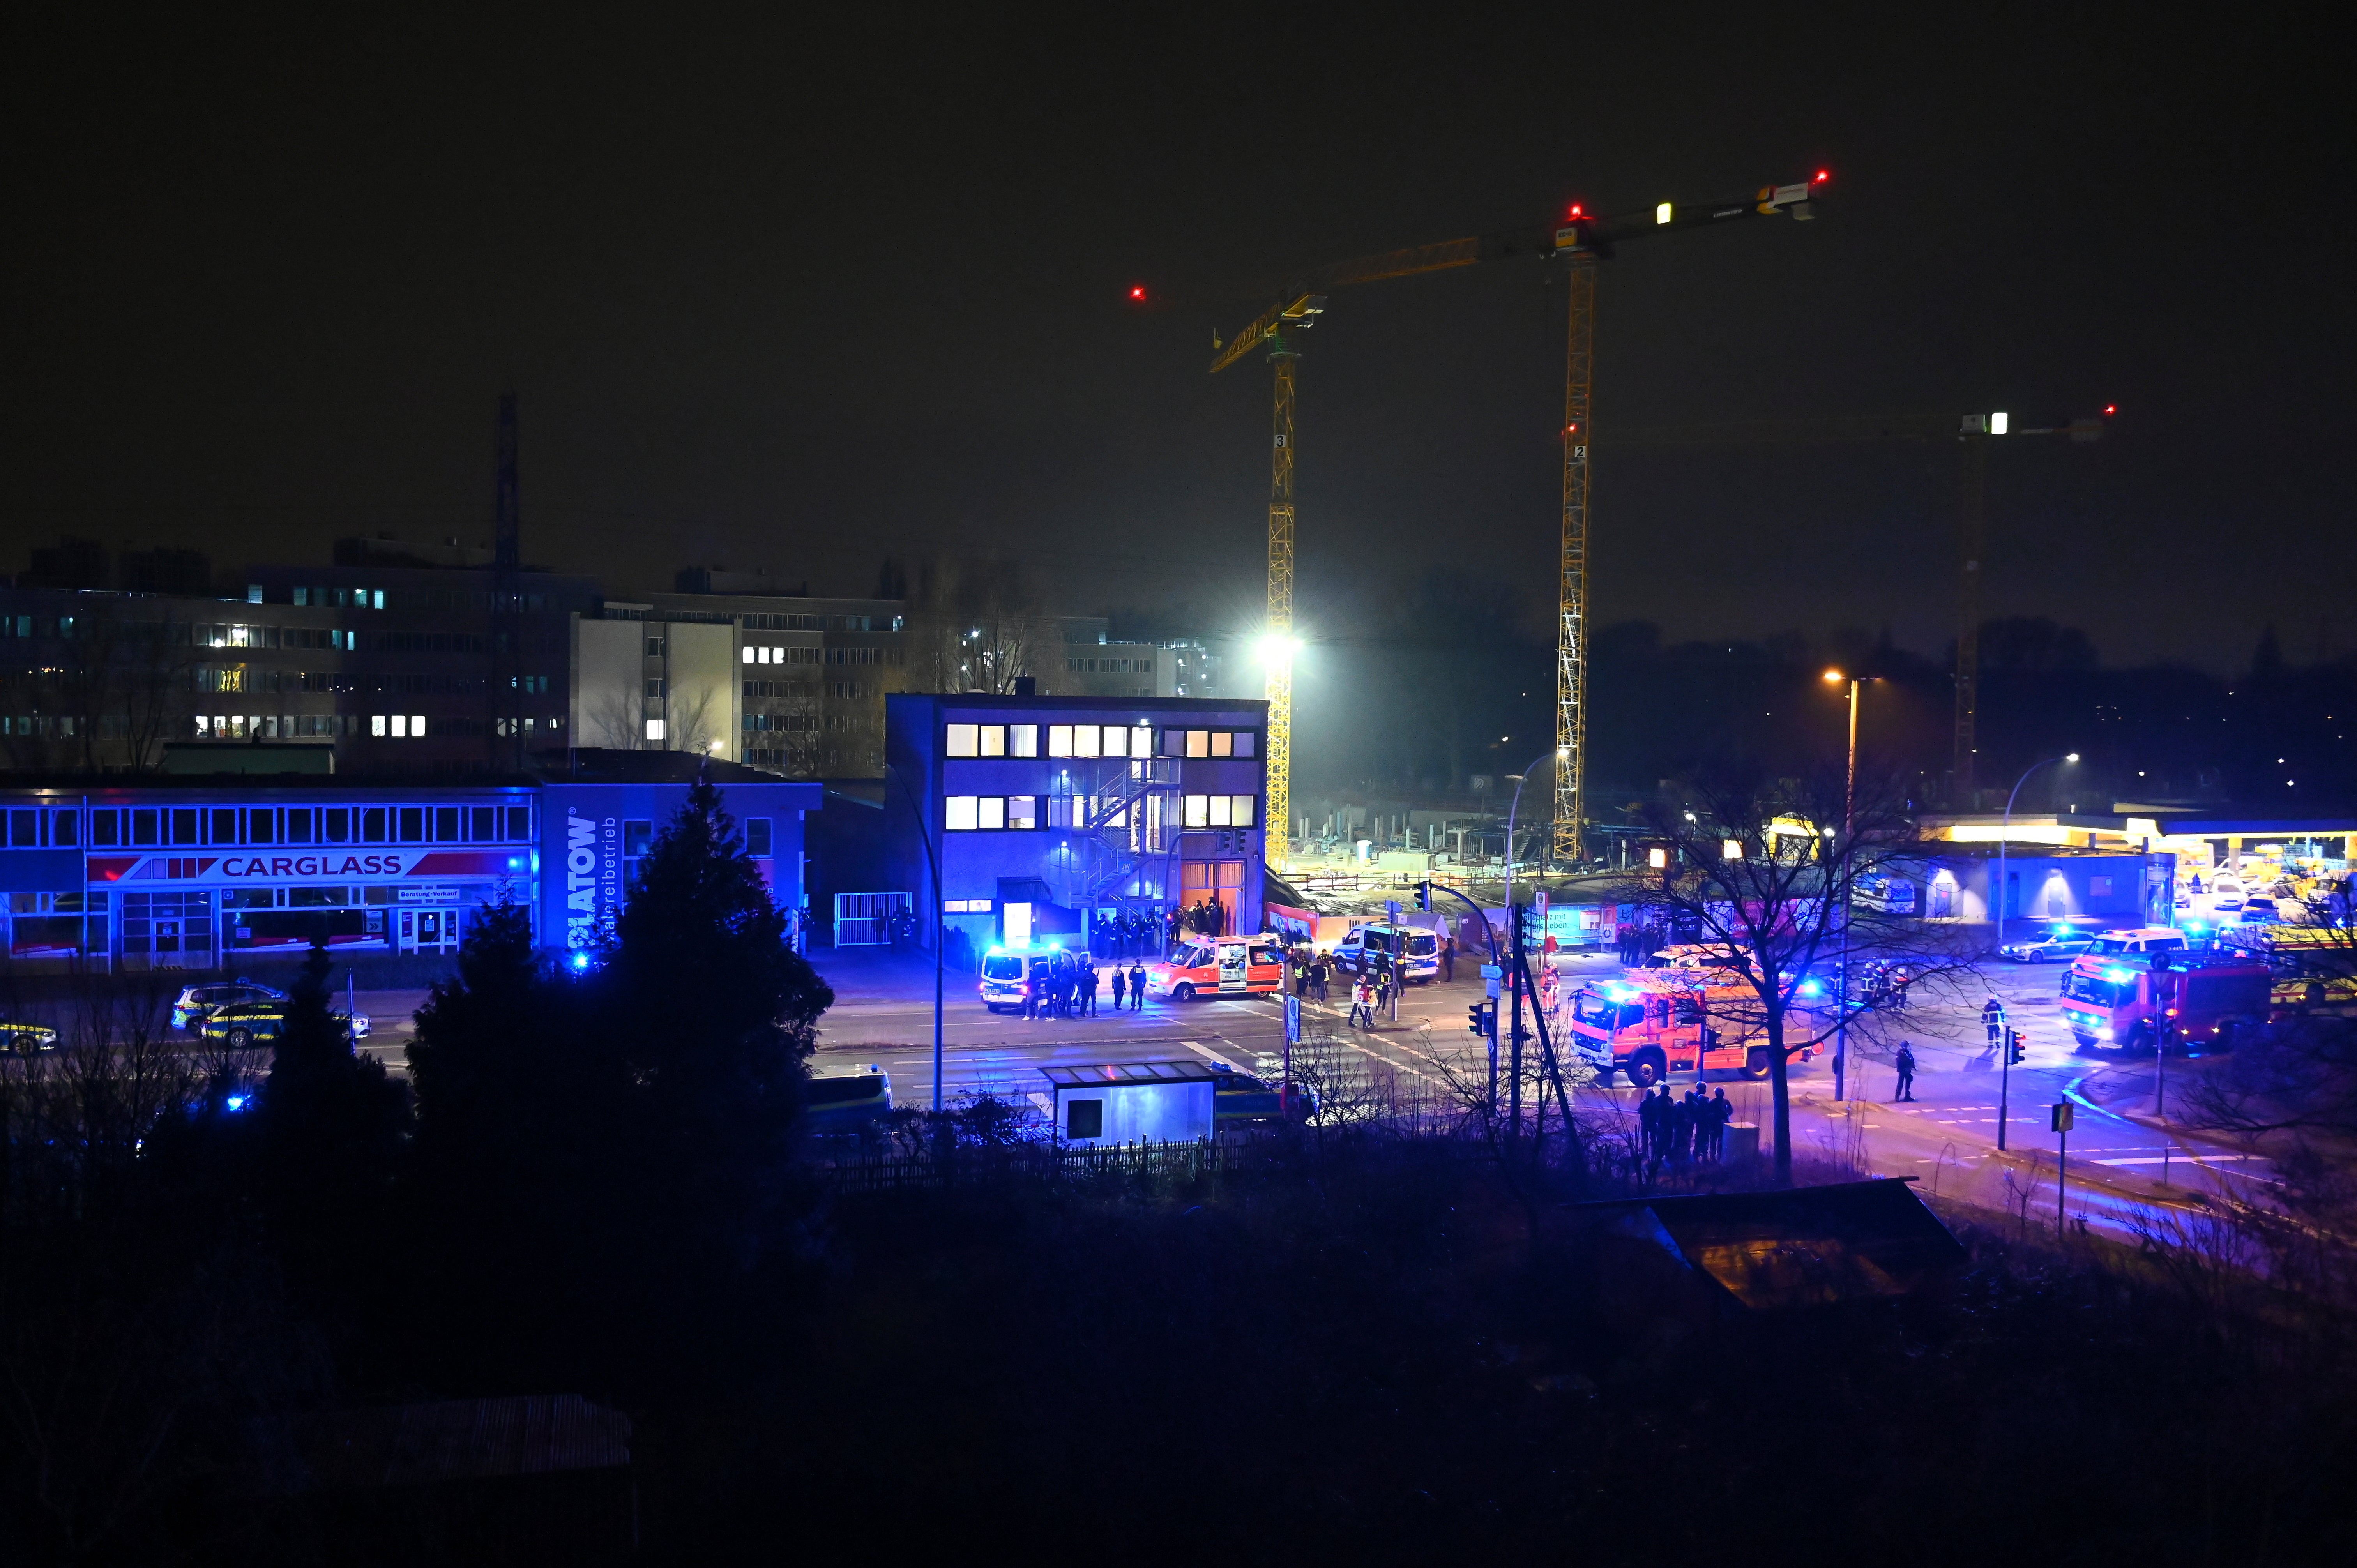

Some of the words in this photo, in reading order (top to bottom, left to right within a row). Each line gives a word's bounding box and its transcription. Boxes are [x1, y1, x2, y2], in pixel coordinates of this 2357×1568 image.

[1276, 435, 1284, 447] 3
[1577, 447, 1583, 457] 2
[221, 855, 402, 876] CARGLASS
